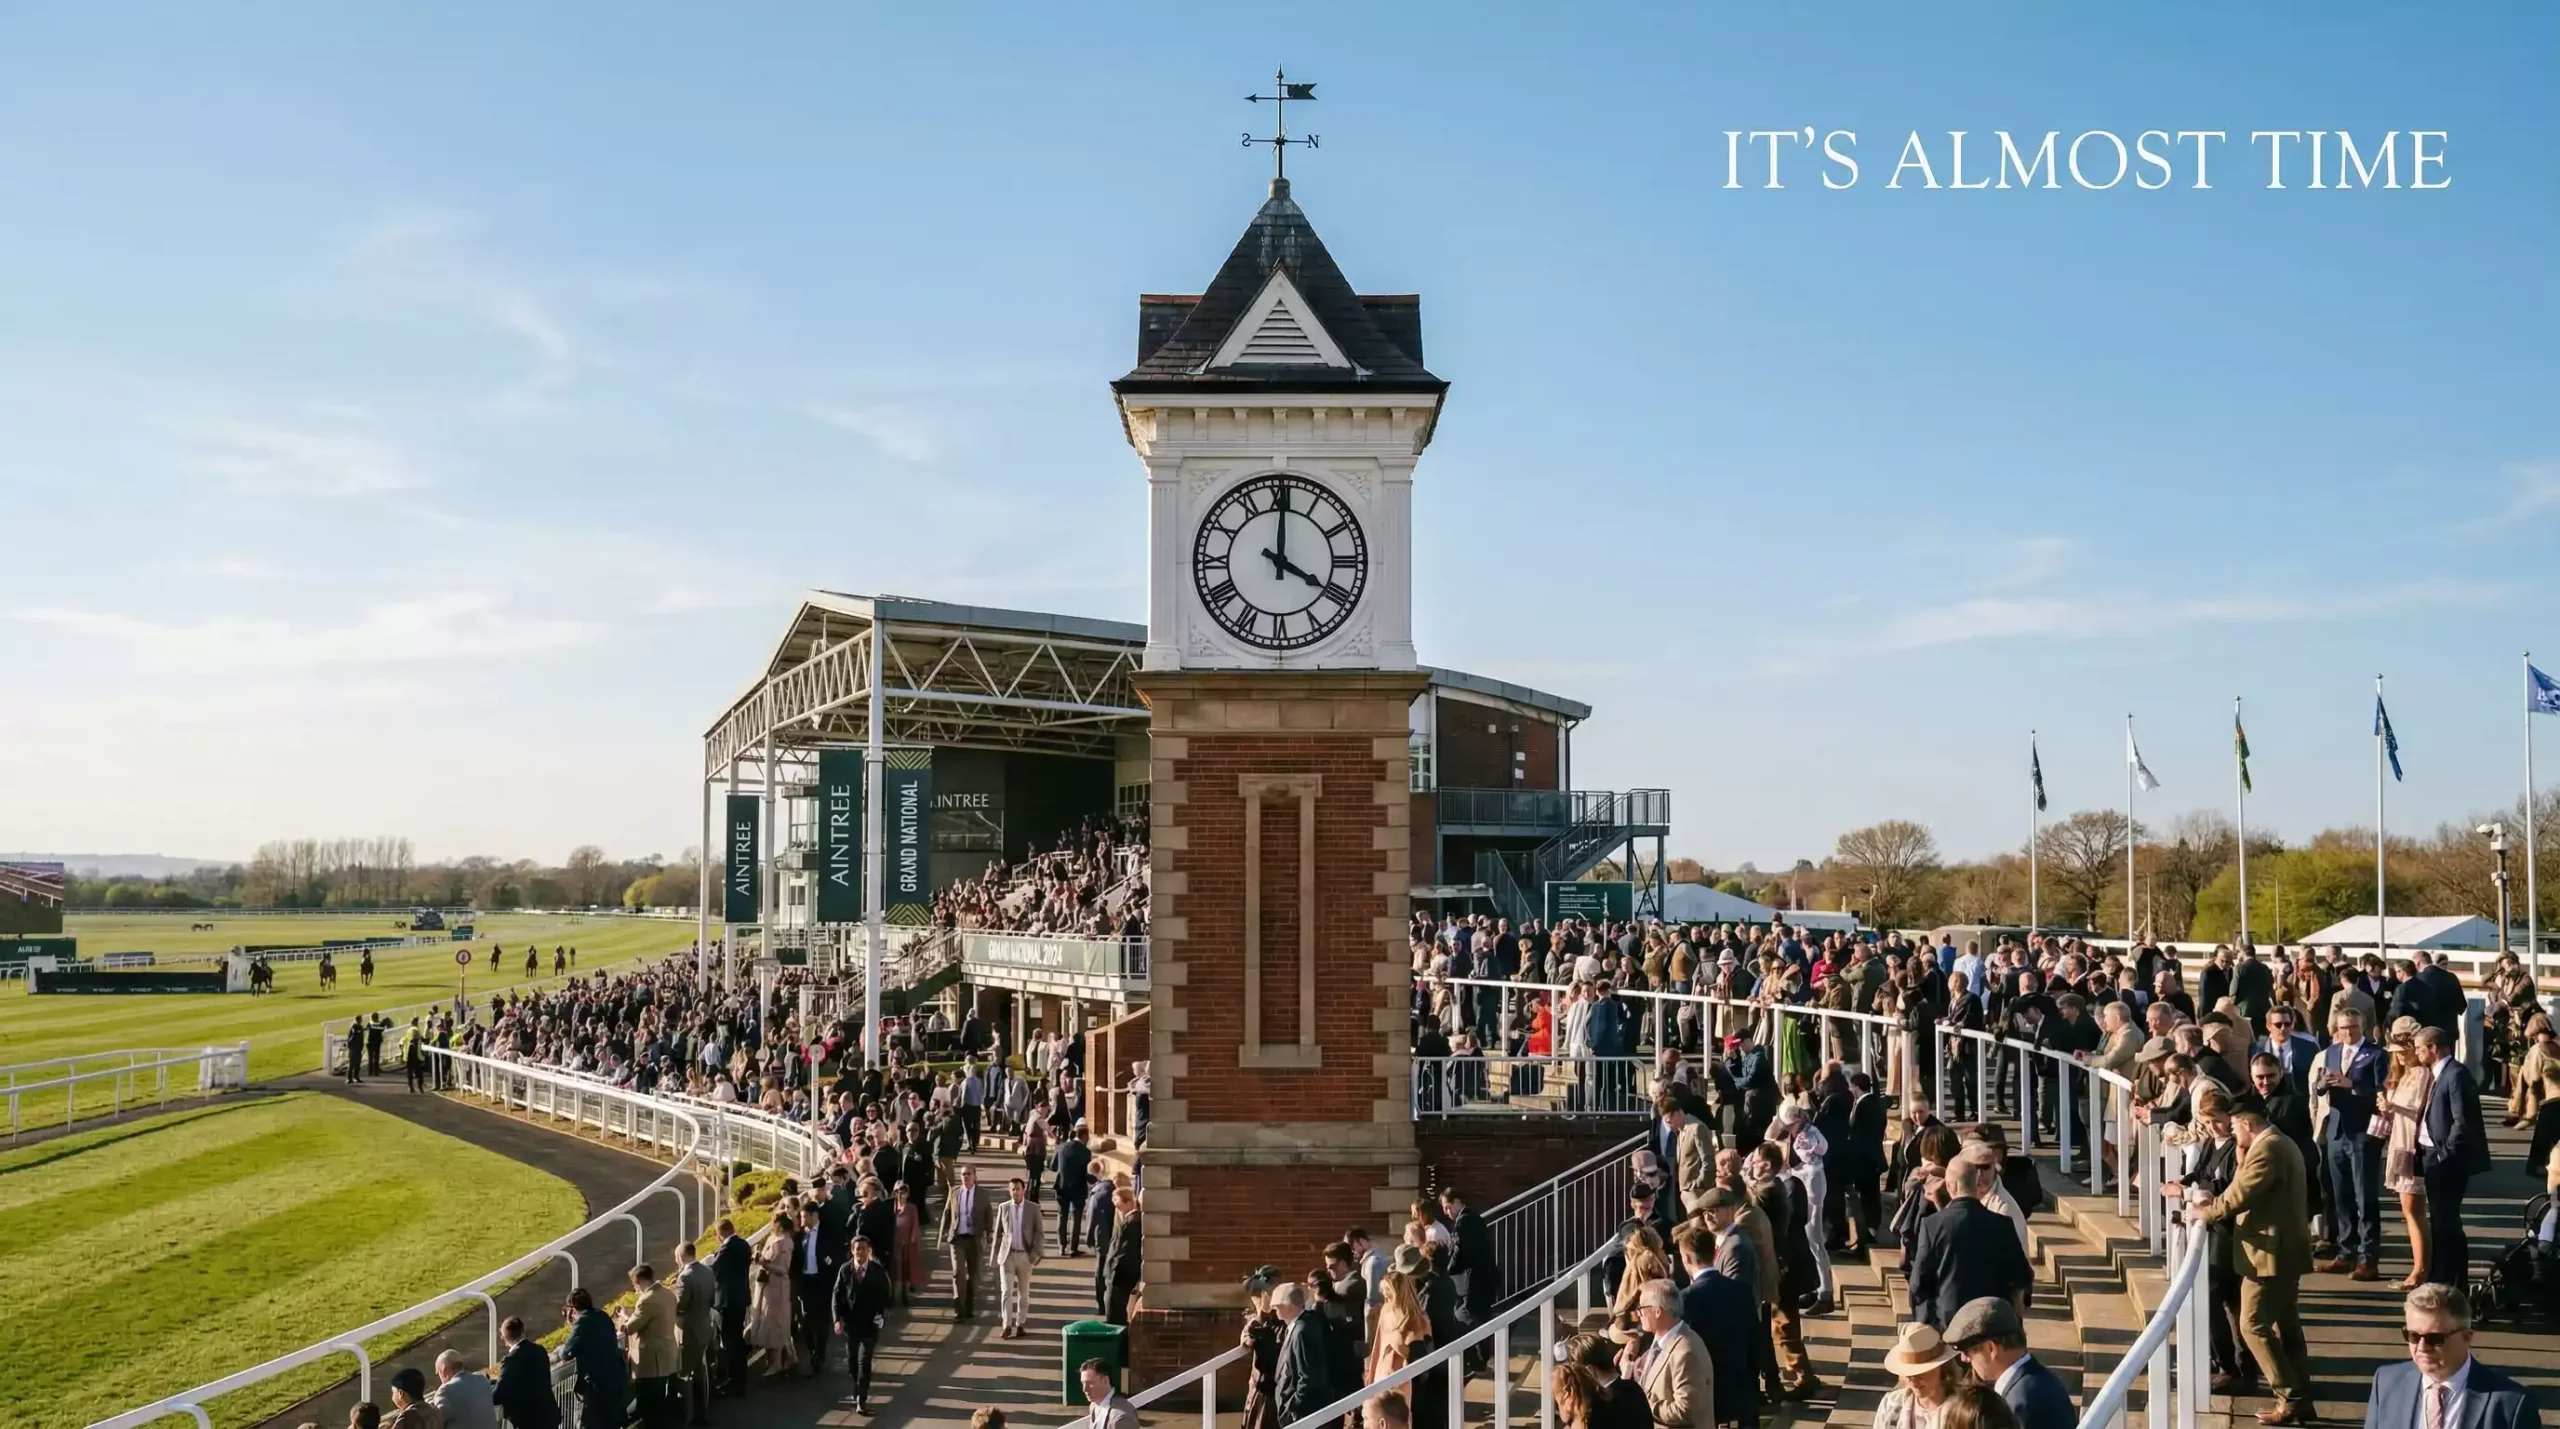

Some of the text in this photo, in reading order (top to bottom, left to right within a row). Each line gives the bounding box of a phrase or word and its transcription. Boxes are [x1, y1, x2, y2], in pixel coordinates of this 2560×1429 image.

[1307, 134, 1320, 149] N
[1234, 493, 1259, 520] XI
[1269, 487, 1290, 511] XI
[1212, 519, 1237, 540] X
[1325, 519, 1348, 539] II
[1203, 554, 1228, 570] IX
[1331, 555, 1356, 569] III
[1209, 579, 1239, 609] VIII
[1233, 604, 1259, 634] VII
[1272, 615, 1288, 639] VI
[934, 793, 990, 808] INTREE
[830, 784, 850, 887] AINTREE
[900, 780, 918, 892] GRAND NATIONAL
[735, 821, 751, 896] AINTREE
